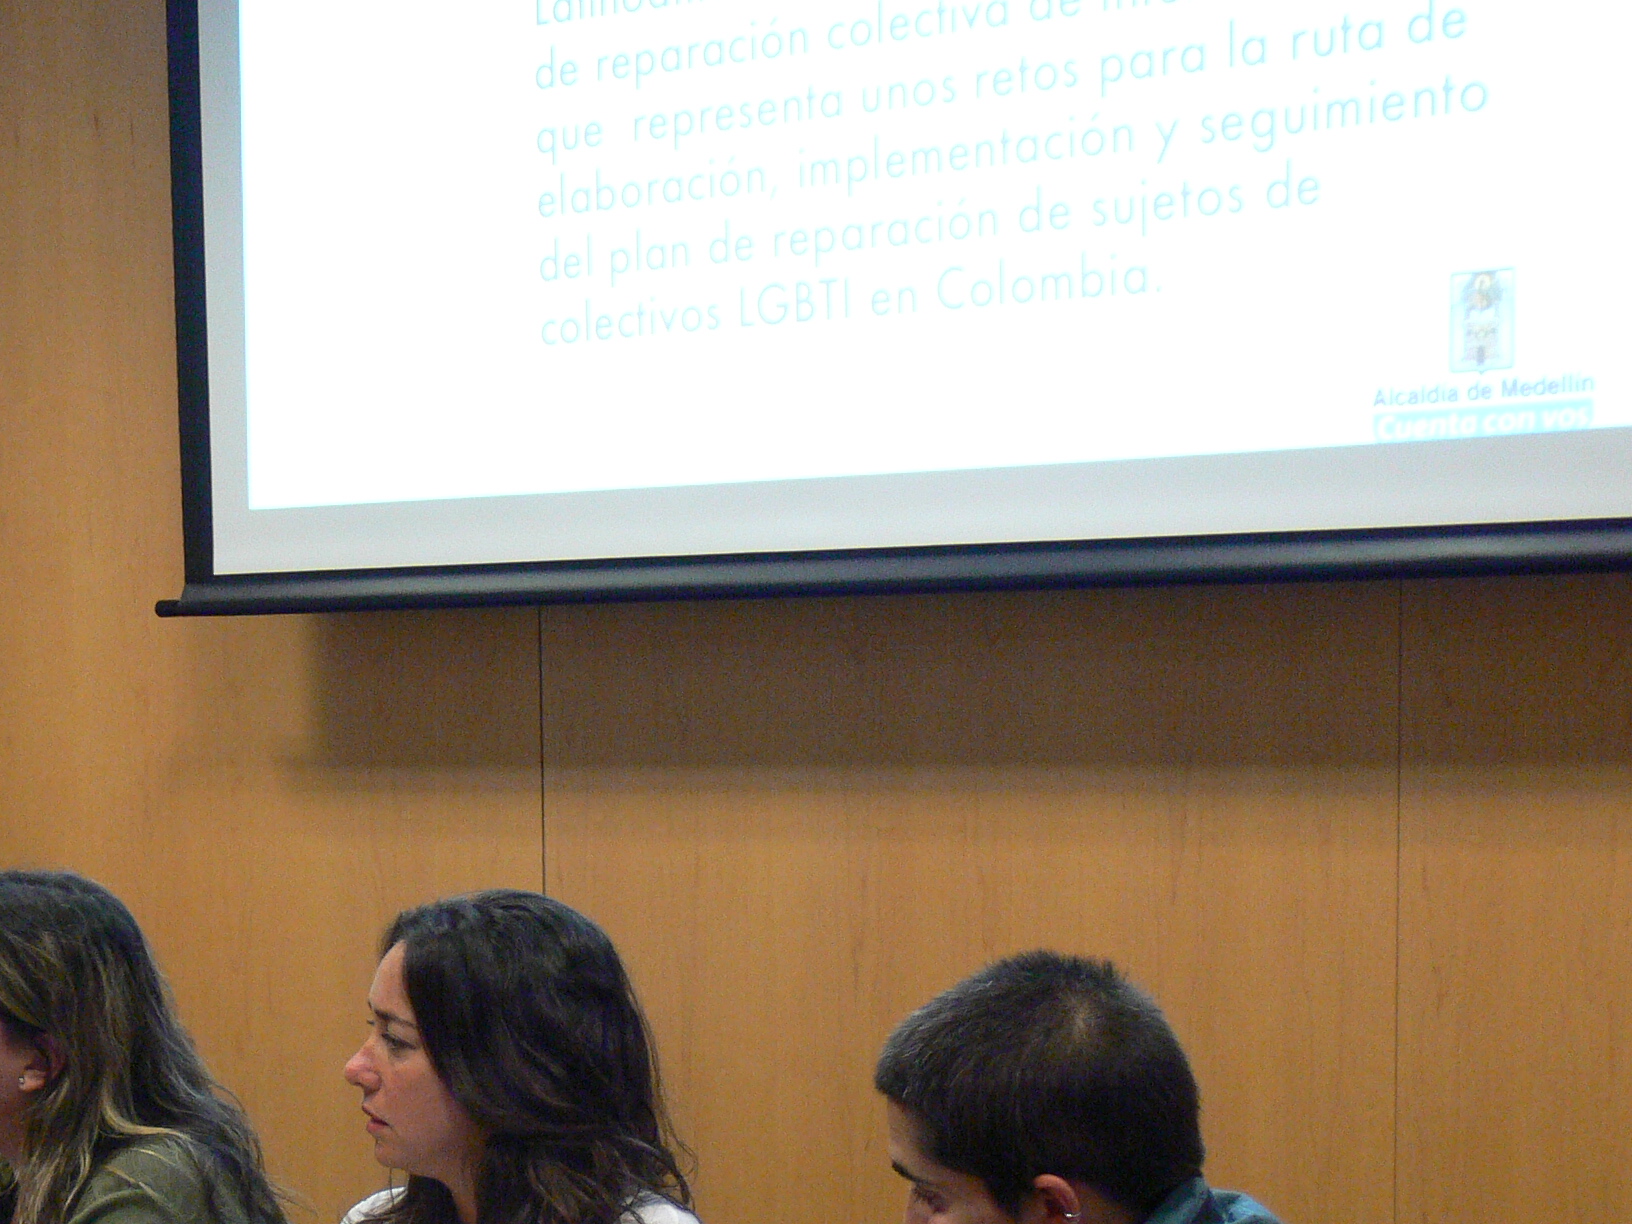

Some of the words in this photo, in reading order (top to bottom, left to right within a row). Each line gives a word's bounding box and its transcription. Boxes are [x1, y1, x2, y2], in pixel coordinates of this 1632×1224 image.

[536, 45, 578, 90] de
[598, 18, 808, 89] reparación
[828, 0, 1008, 49] colectiva
[537, 122, 602, 165] que
[634, 86, 842, 150] representa
[863, 76, 956, 112] unos
[976, 56, 1078, 98] retos
[1101, 44, 1206, 98] para
[1229, 19, 1267, 67] la
[1292, 14, 1384, 60] ruta
[1408, 0, 1467, 44] de
[539, 157, 776, 217] elaboración,
[800, 112, 1133, 196] implementación
[1156, 120, 1179, 164] y
[1201, 75, 1489, 153] seguimiento
[540, 234, 592, 281] del
[611, 229, 689, 287] plan
[710, 220, 754, 263] de
[775, 199, 997, 267] reparación
[1019, 186, 1070, 232] de
[1093, 180, 1244, 236] sujetos
[1267, 159, 1320, 208] de
[542, 298, 720, 345] colectivos
[741, 278, 848, 326] LGBTI
[872, 287, 916, 315] en
[938, 252, 1160, 309] Colombia.
[1377, 411, 1477, 440] Cuenta
[1482, 411, 1535, 432] con
[1541, 405, 1589, 427] vos
[1467, 381, 1492, 401] de
